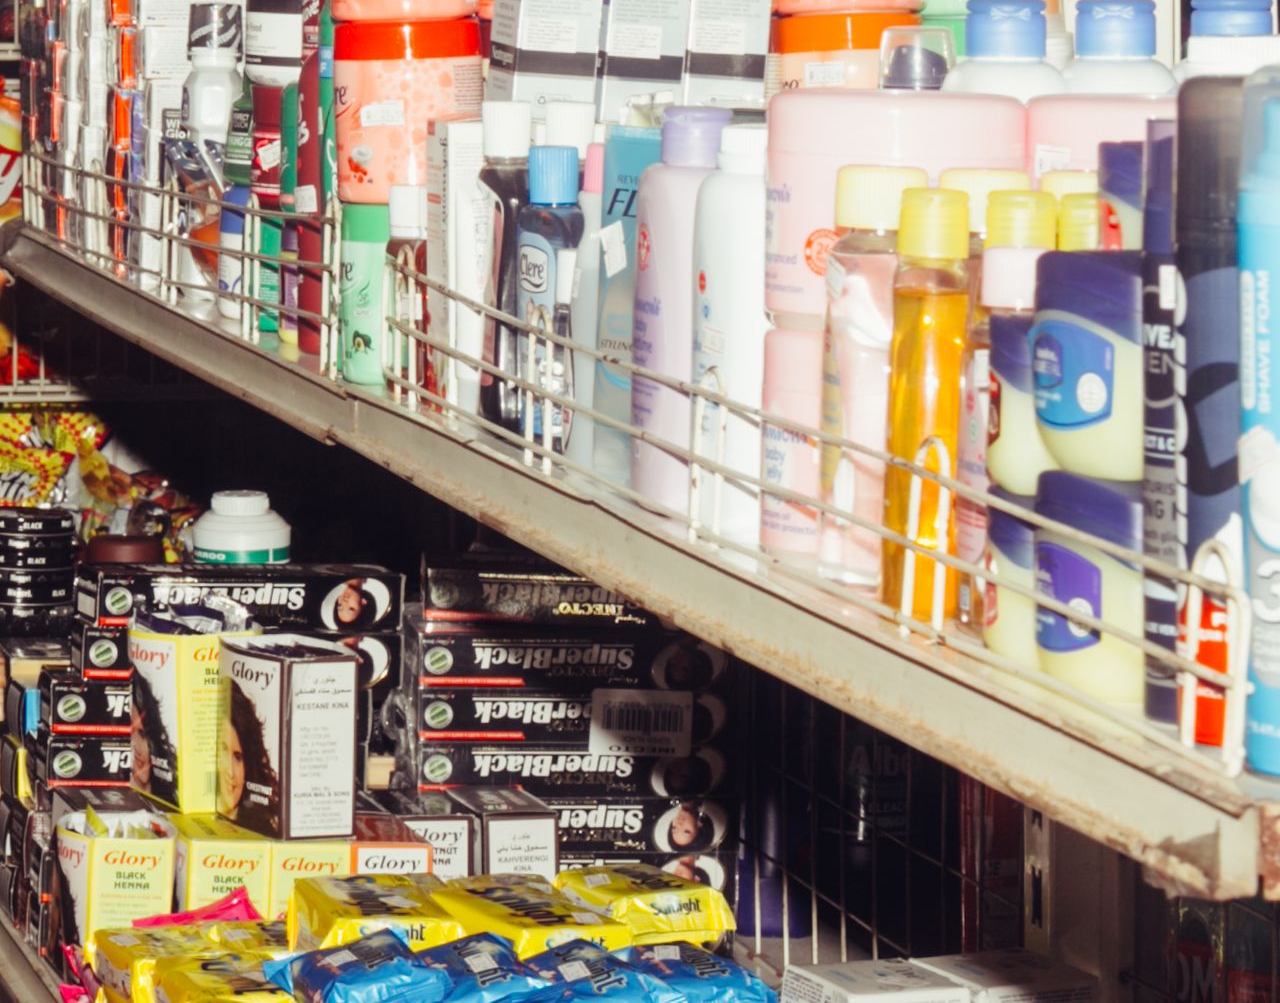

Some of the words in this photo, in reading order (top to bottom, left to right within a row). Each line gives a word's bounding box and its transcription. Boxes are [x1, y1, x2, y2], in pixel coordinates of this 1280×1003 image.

[521, 243, 547, 277] Clere
[1256, 269, 1271, 333] FOAM
[1257, 338, 1272, 413] SHAVE
[23, 521, 42, 530] BLACK
[27, 556, 46, 566] BLACK
[473, 643, 636, 671] SuperBlack
[231, 660, 274, 690] Glory
[297, 702, 330, 710] KESTANE
[608, 743, 678, 755] INECTO
[473, 751, 636, 777] SuperBlack
[558, 805, 644, 833] Super
[104, 850, 162, 871] Glory
[203, 854, 260, 873] Glory
[282, 857, 340, 874] Glory
[365, 855, 421, 875] Glory
[498, 855, 549, 863] KAHVERENGI
[115, 871, 146, 880] BLACK
[213, 875, 244, 884] BLACK
[114, 881, 149, 890] HENNA
[650, 897, 702, 916] Sunlight
